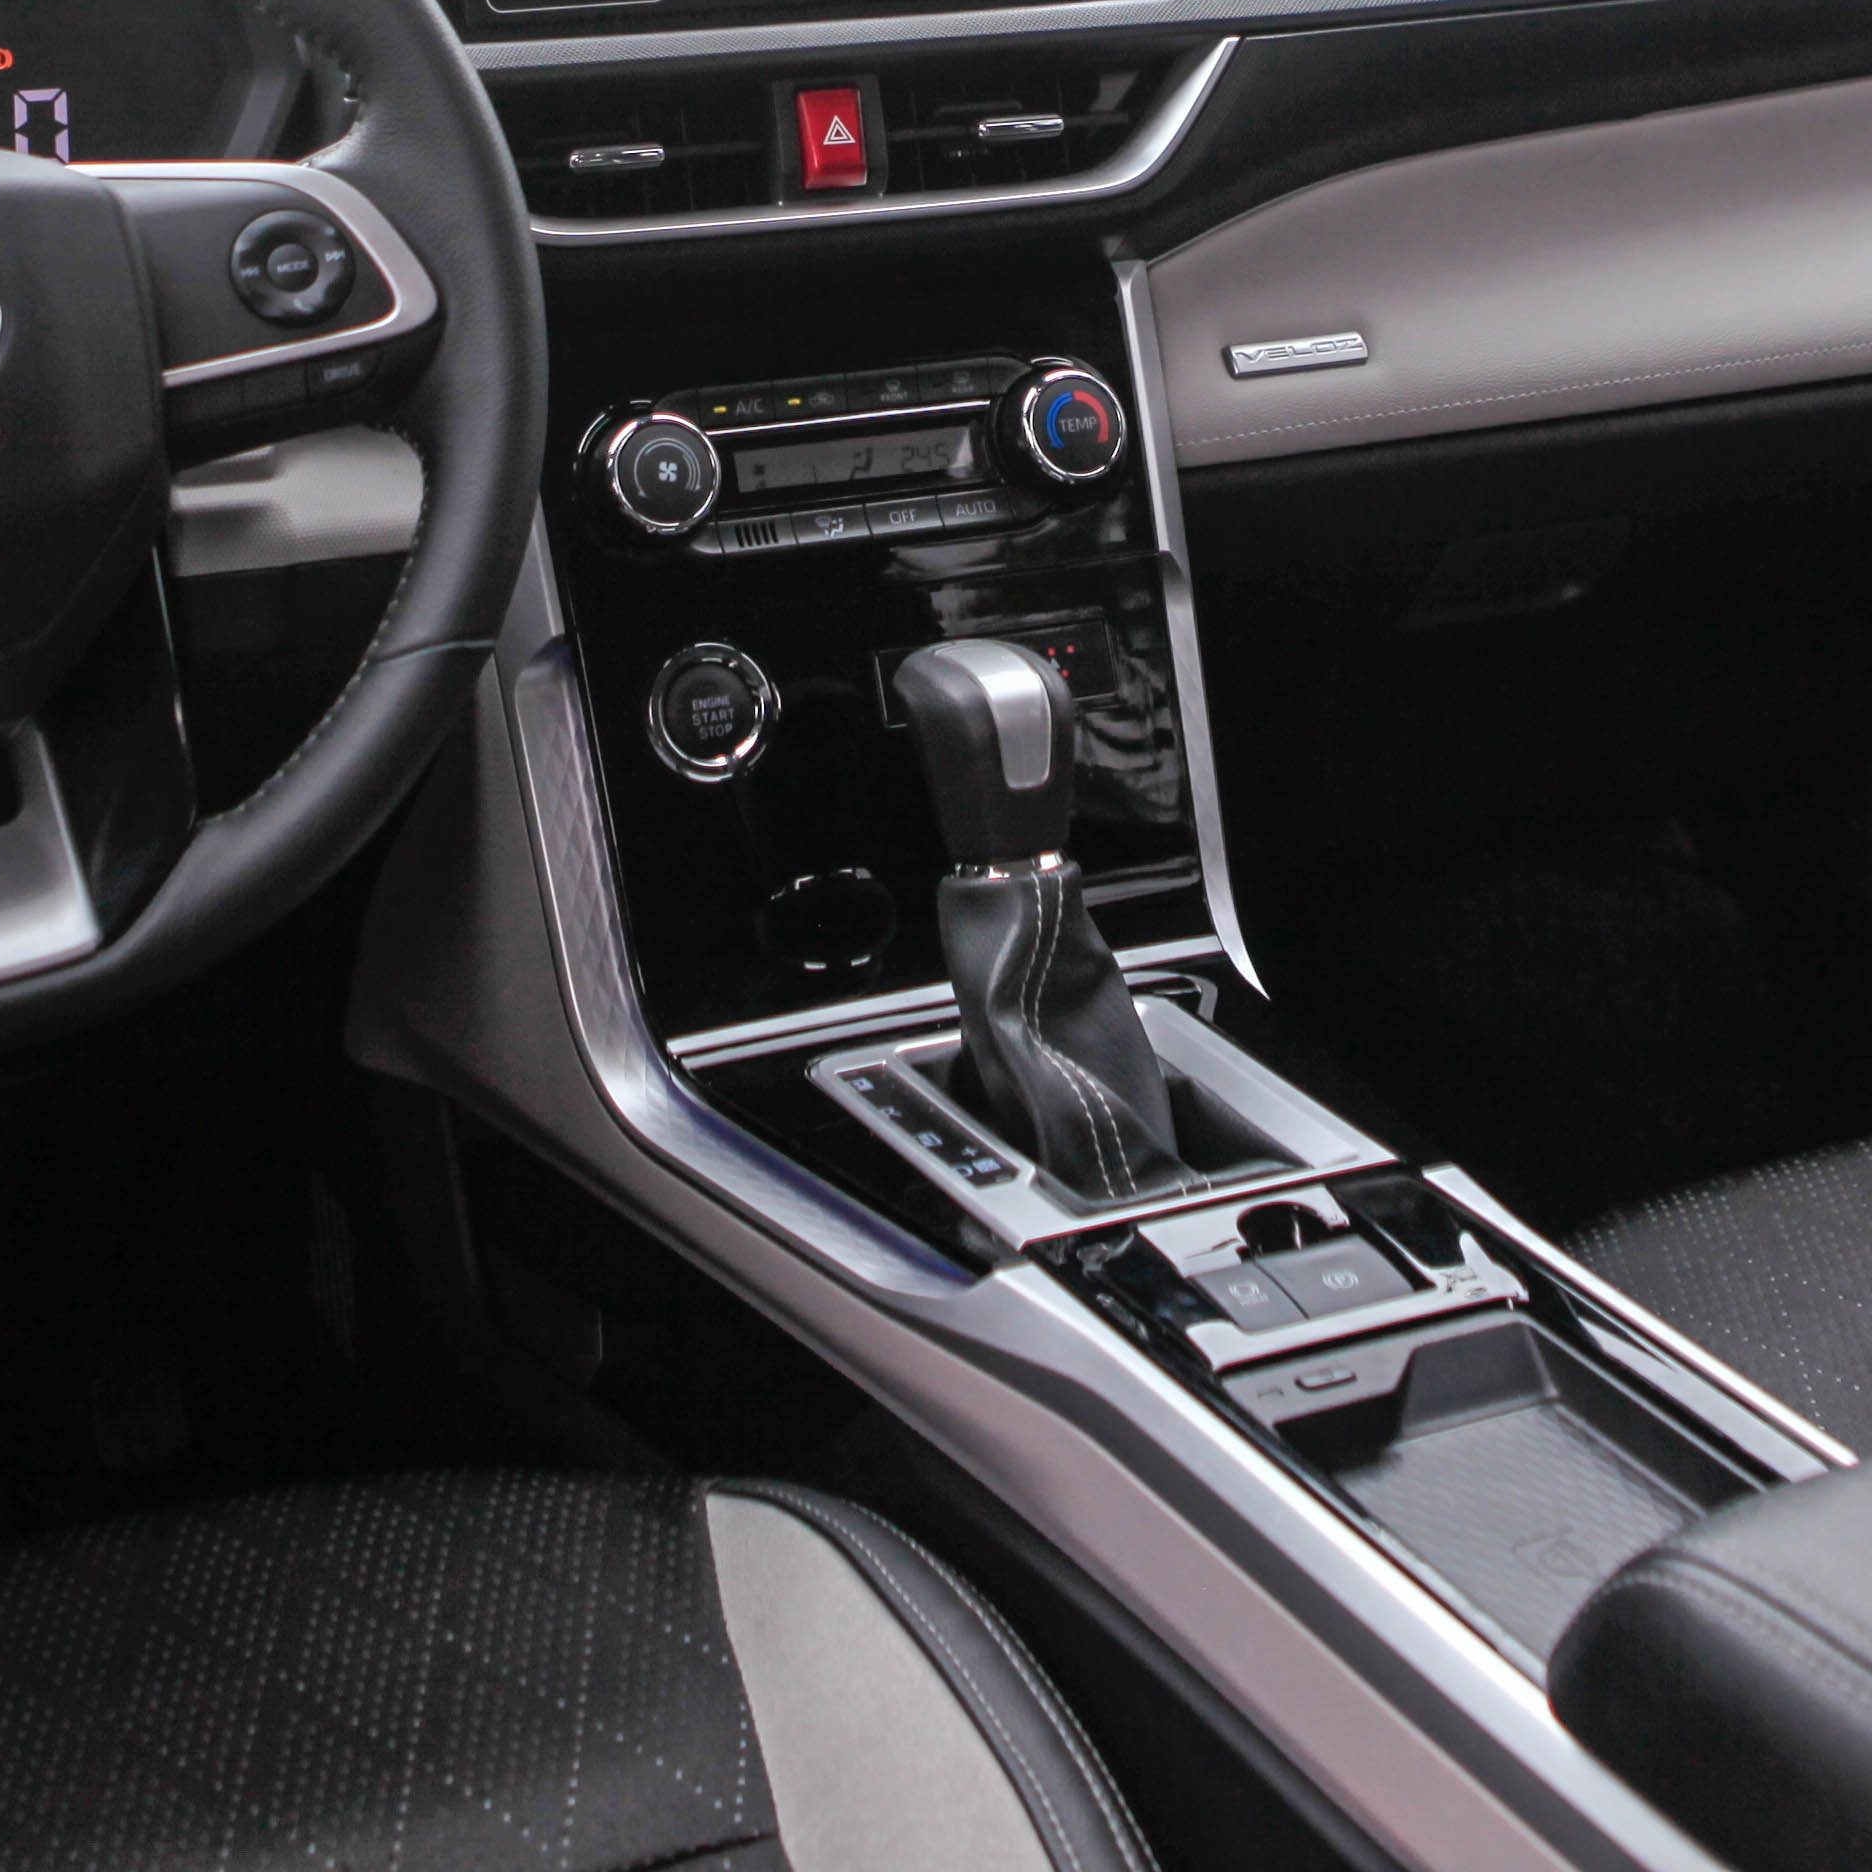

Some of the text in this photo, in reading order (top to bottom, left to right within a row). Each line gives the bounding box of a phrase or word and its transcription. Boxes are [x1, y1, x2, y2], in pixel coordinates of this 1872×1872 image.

[1234, 337, 1364, 364] VELOZ
[735, 397, 765, 415] A/C
[1059, 415, 1097, 433] TEMP
[888, 509, 918, 526] OFF
[955, 500, 997, 518] AUTO
[692, 708, 735, 726] START
[698, 723, 734, 740] STOP
